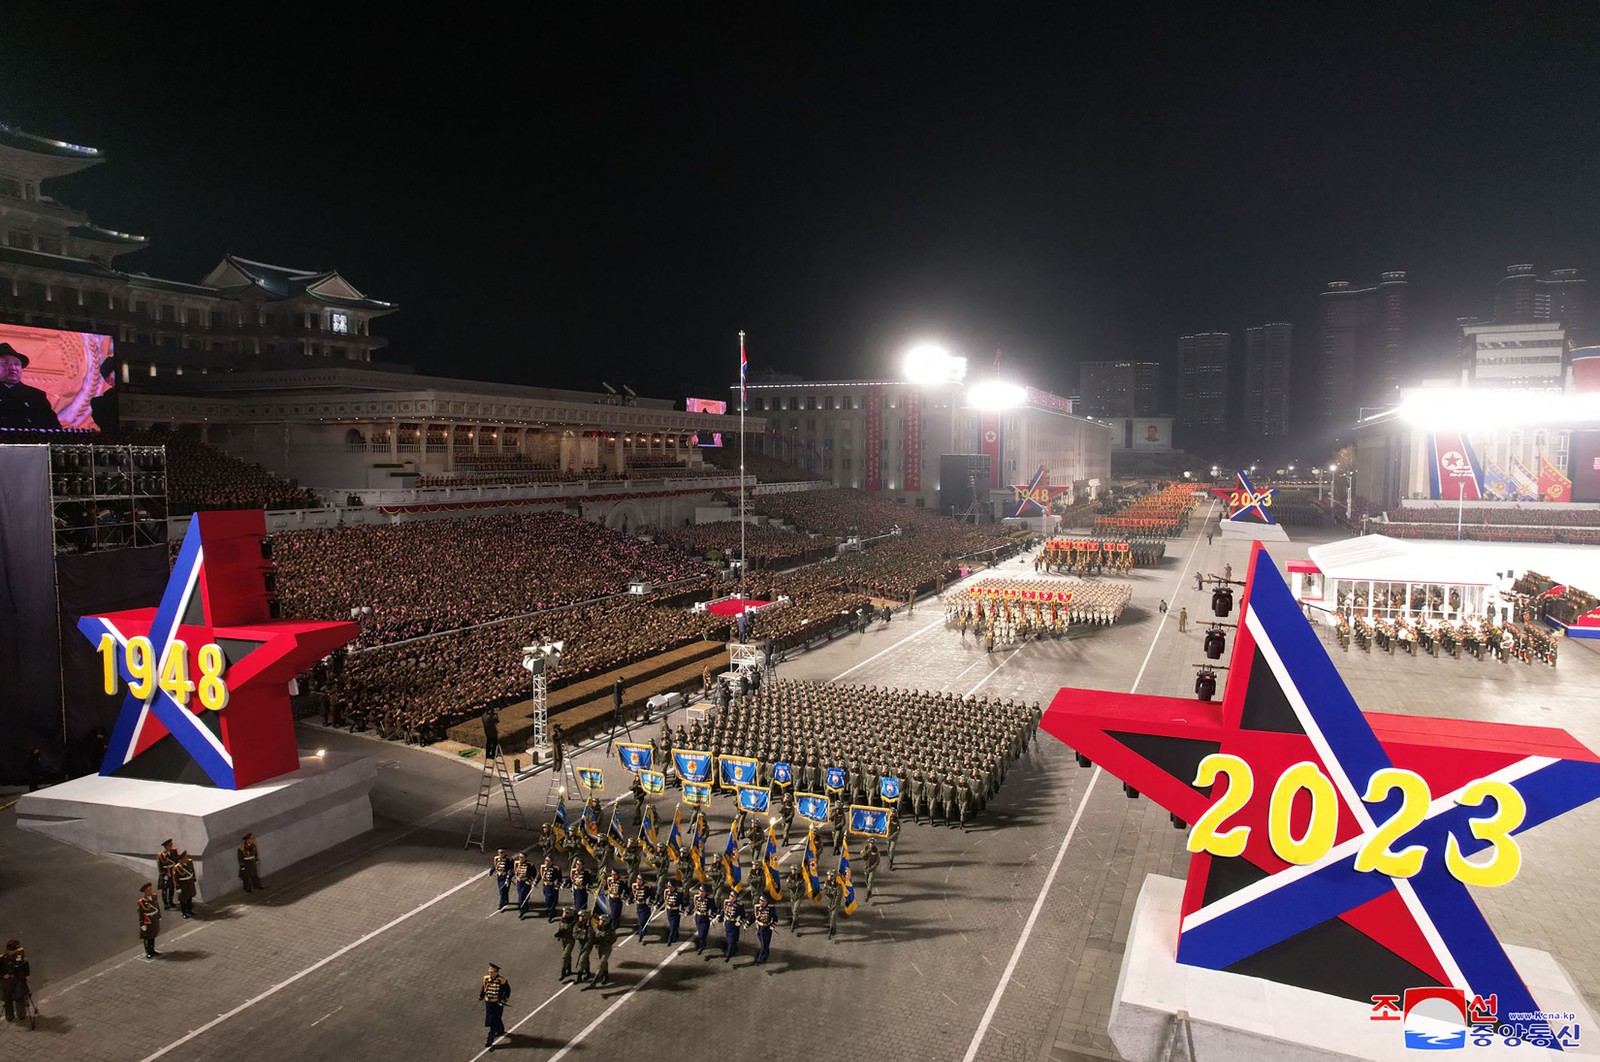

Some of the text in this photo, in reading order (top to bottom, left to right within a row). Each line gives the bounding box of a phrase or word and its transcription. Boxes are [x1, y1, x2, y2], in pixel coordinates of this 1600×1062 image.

[1013, 488, 1049, 502] 1948
[1230, 492, 1272, 507] 2023
[97, 632, 229, 711] 1948
[1187, 753, 1527, 888] 2023
